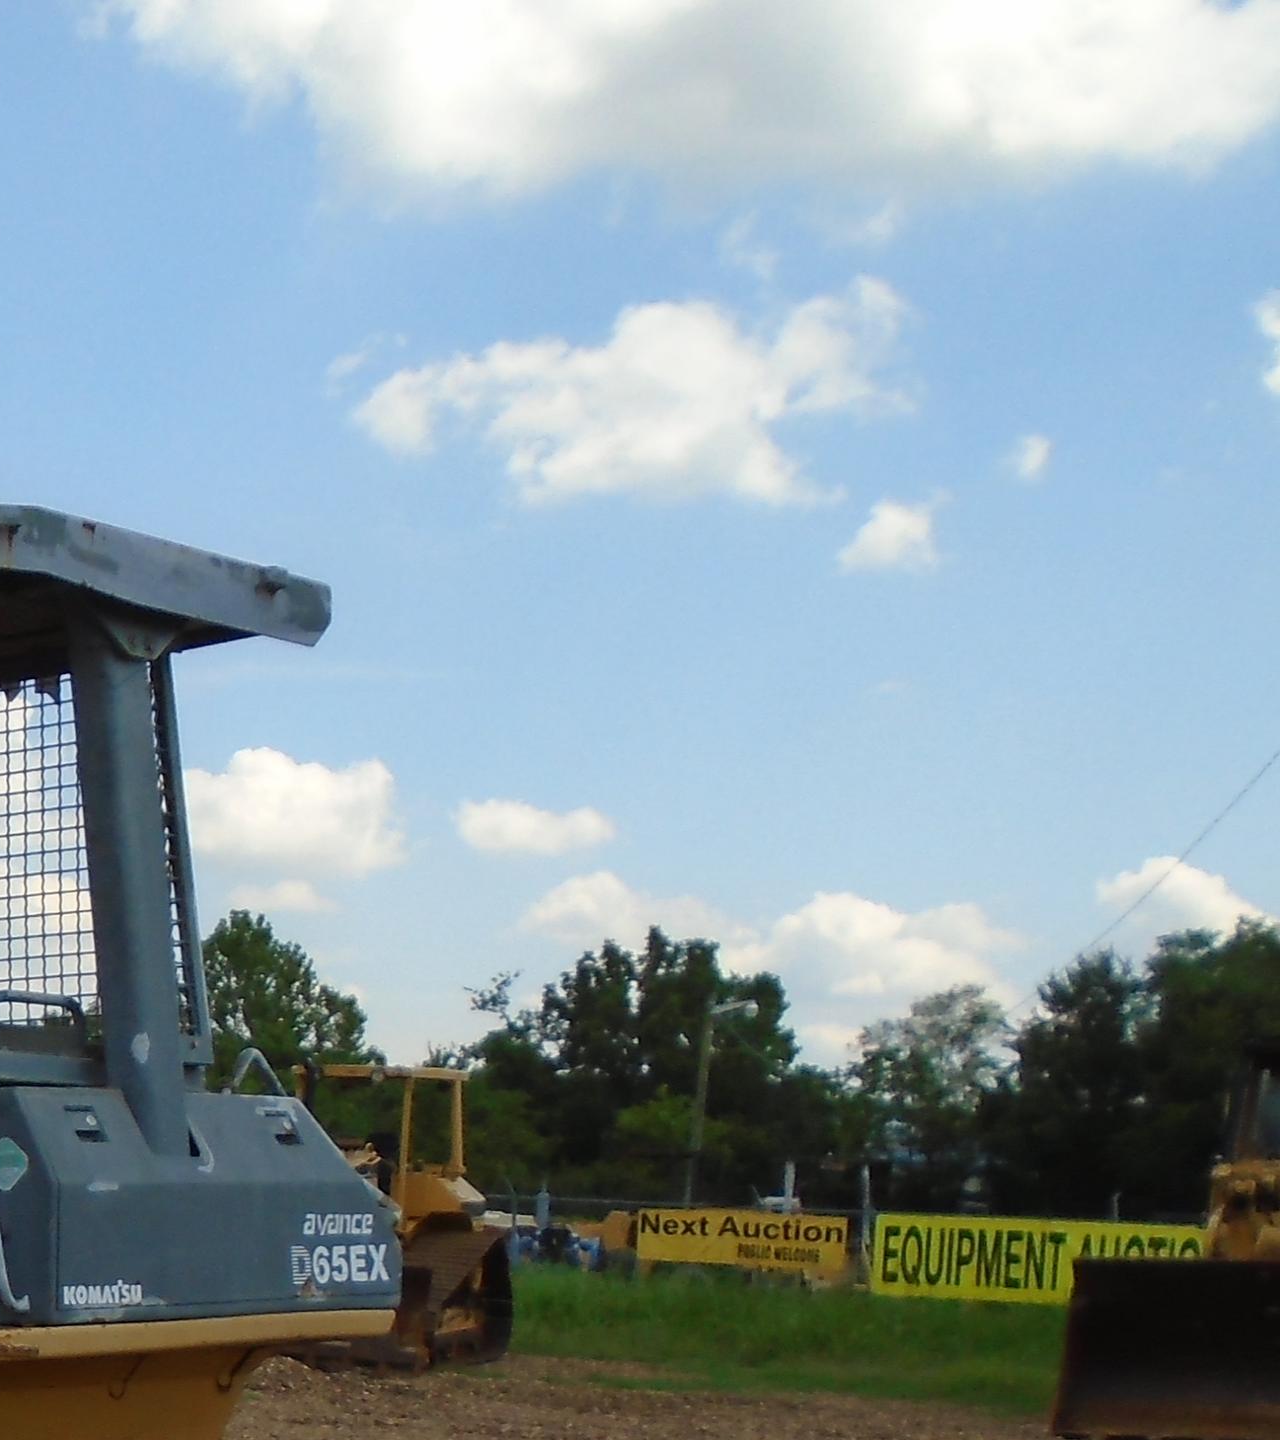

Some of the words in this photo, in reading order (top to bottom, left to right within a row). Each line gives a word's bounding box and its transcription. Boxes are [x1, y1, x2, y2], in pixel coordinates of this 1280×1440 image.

[303, 1213, 375, 1236] avance
[640, 1213, 709, 1237] Next
[718, 1215, 844, 1243] Auction
[290, 1244, 390, 1285] D65EX
[881, 1225, 1068, 1292] EQUIPMENT
[63, 1279, 143, 1305] KOMATSU
